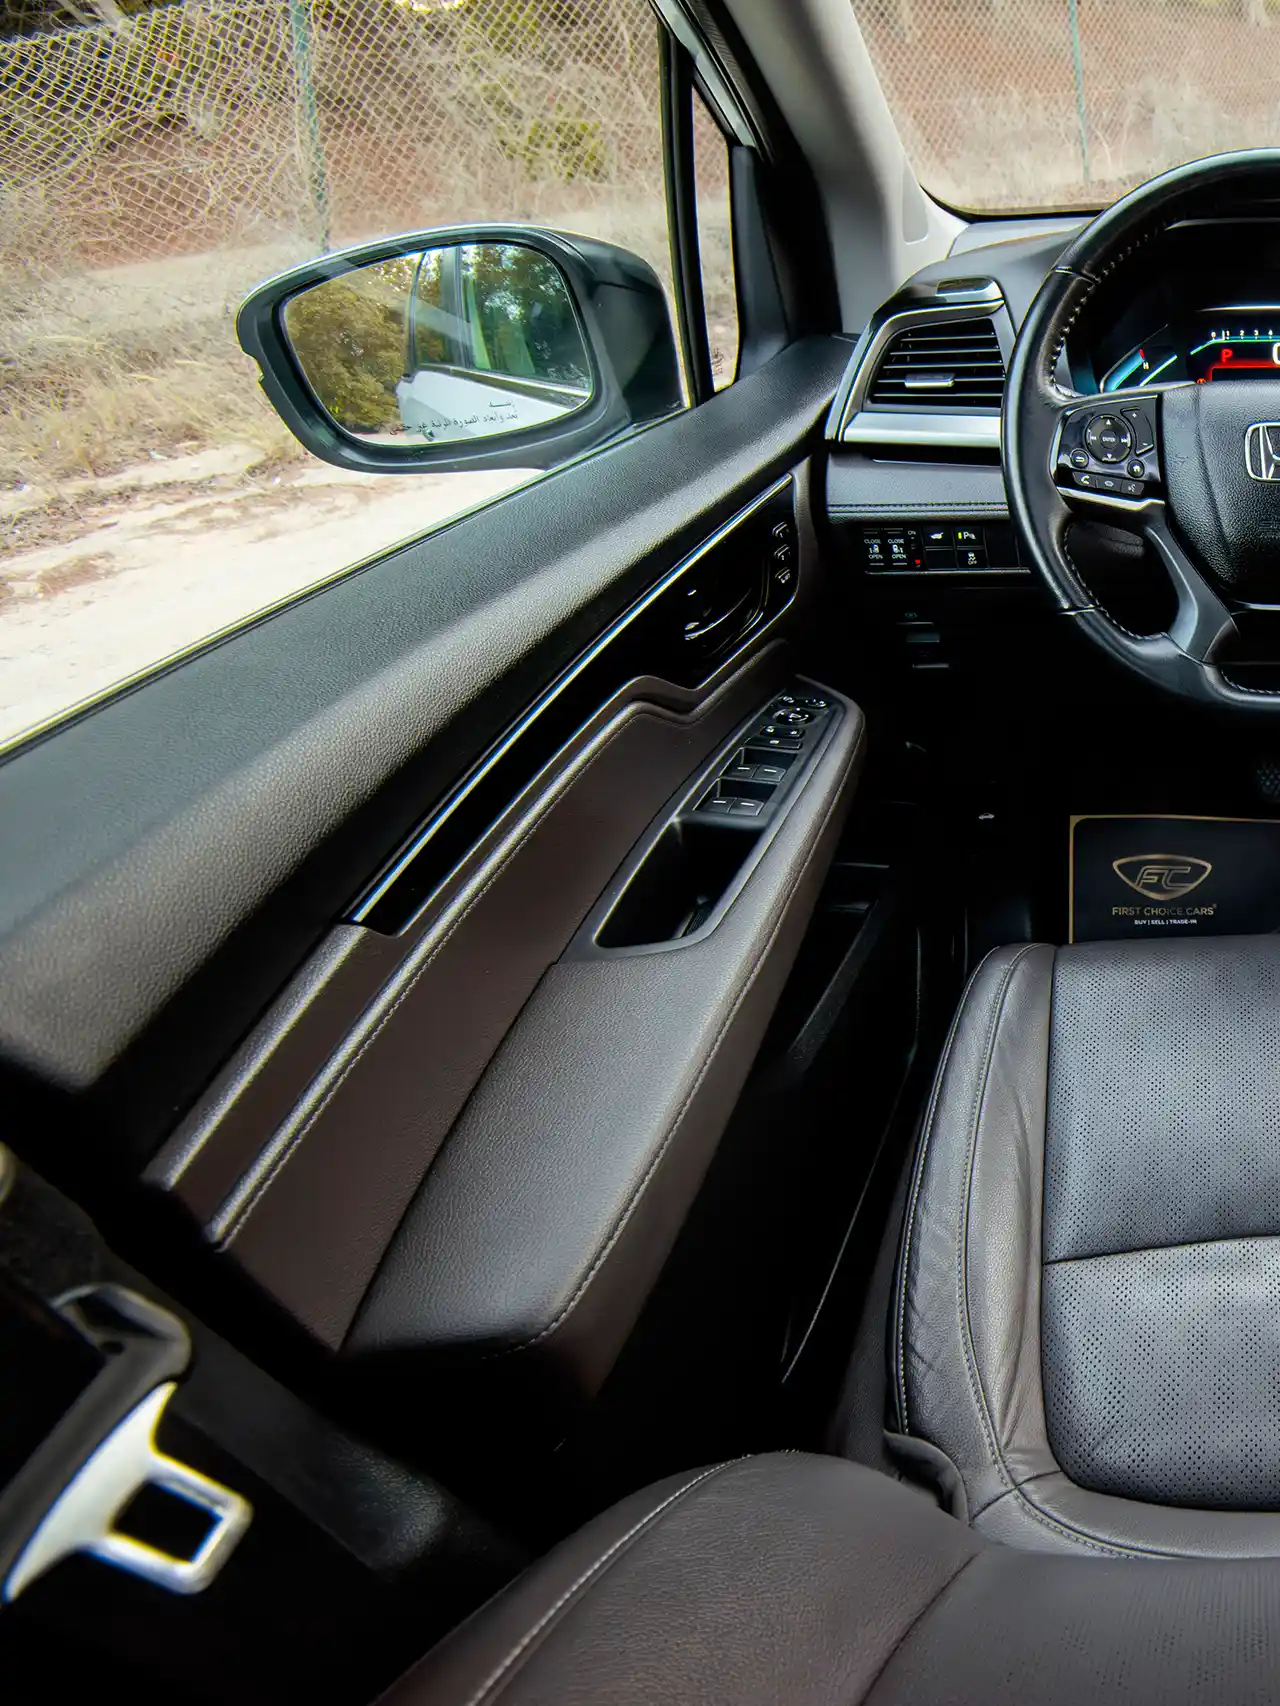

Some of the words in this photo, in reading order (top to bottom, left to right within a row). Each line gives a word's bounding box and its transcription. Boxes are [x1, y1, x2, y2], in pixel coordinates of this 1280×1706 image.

[1221, 349, 1233, 363] P
[1143, 362, 1149, 370] H
[1112, 907, 1141, 916] FIRST
[1143, 907, 1184, 916] CHOICE
[1185, 907, 1214, 916] CARS
